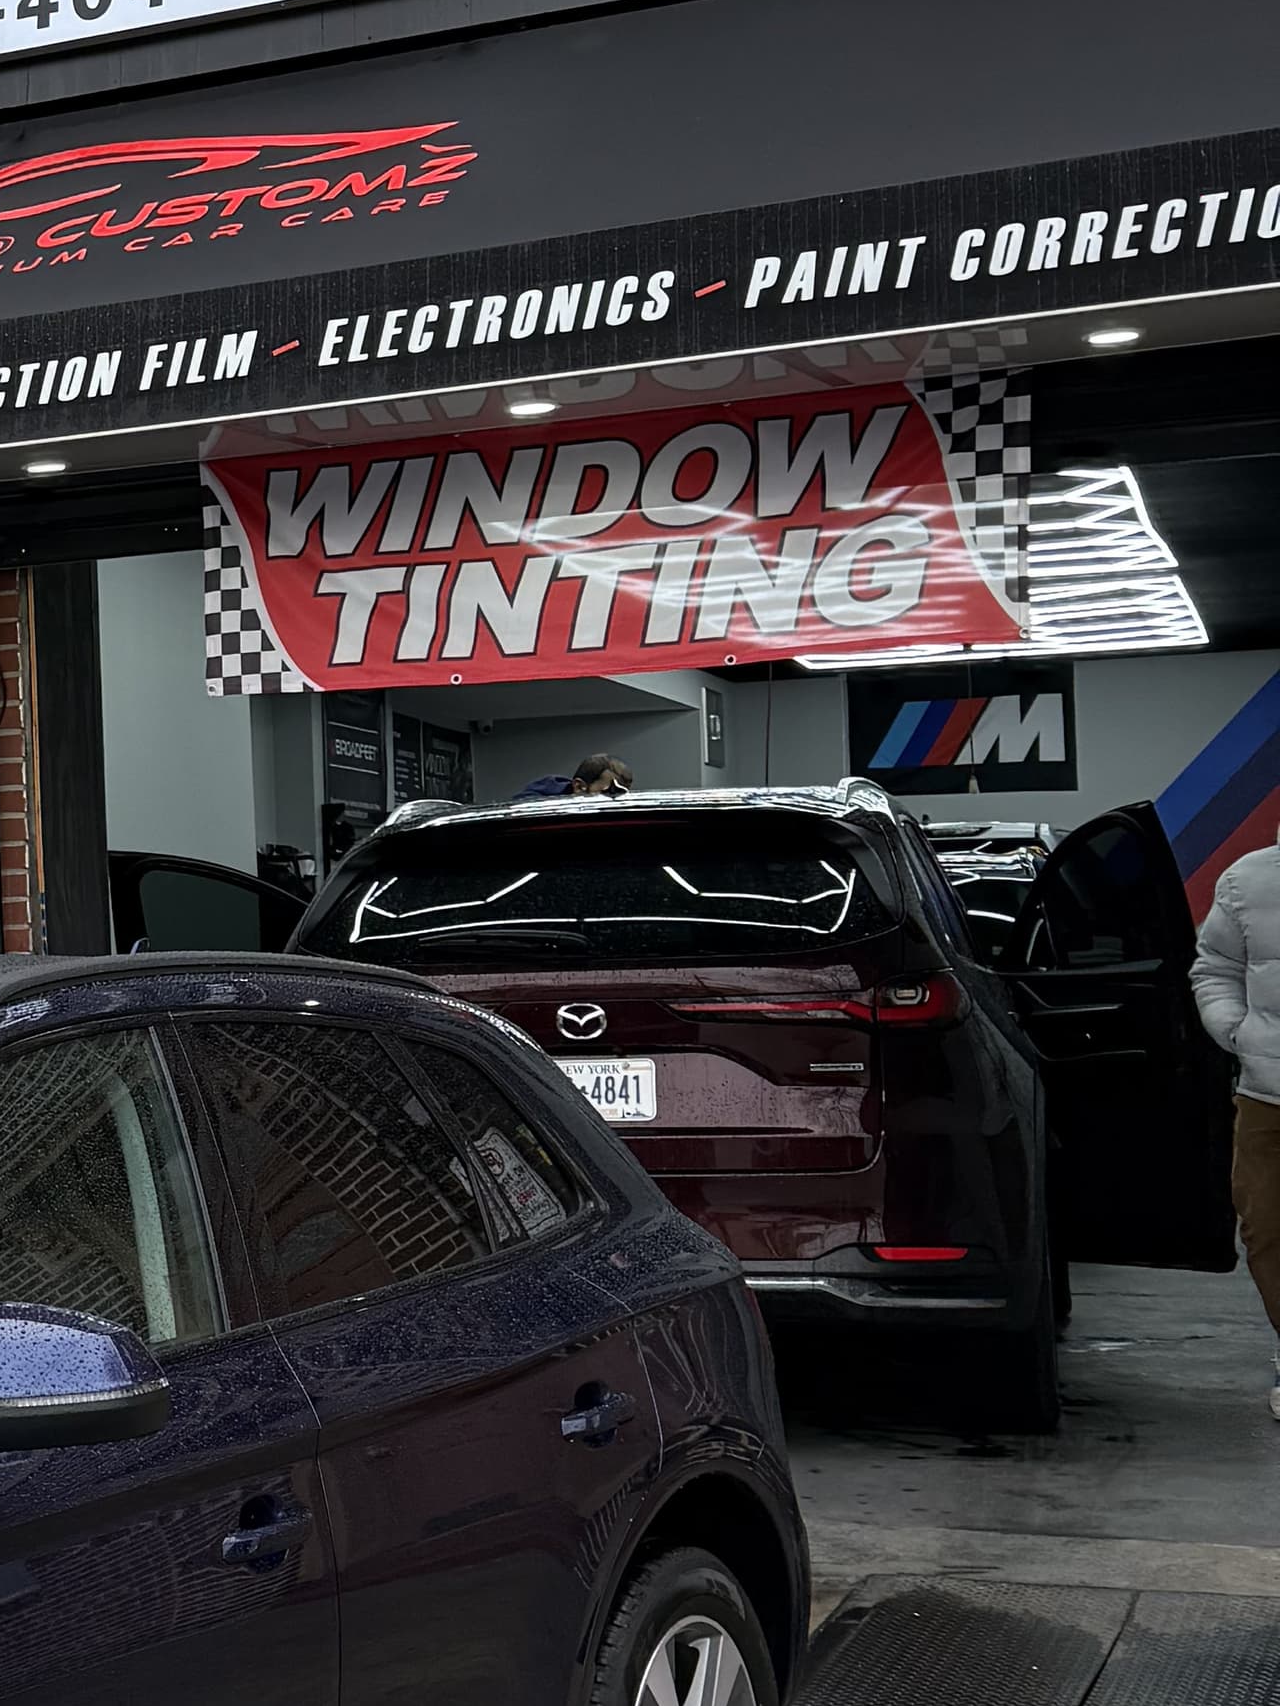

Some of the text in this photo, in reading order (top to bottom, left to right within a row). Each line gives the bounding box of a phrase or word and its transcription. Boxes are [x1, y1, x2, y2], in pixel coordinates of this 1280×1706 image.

[36, 143, 480, 251] CUSTOMZ
[123, 222, 244, 253] CAR
[280, 188, 451, 229] CARE
[138, 328, 259, 394] FILM
[315, 268, 677, 369] ELECTRONICS
[743, 235, 927, 309] PAINT
[263, 401, 914, 560] WINDOW
[312, 512, 933, 668] TINTING
[586, 1064, 622, 1075] YORK
